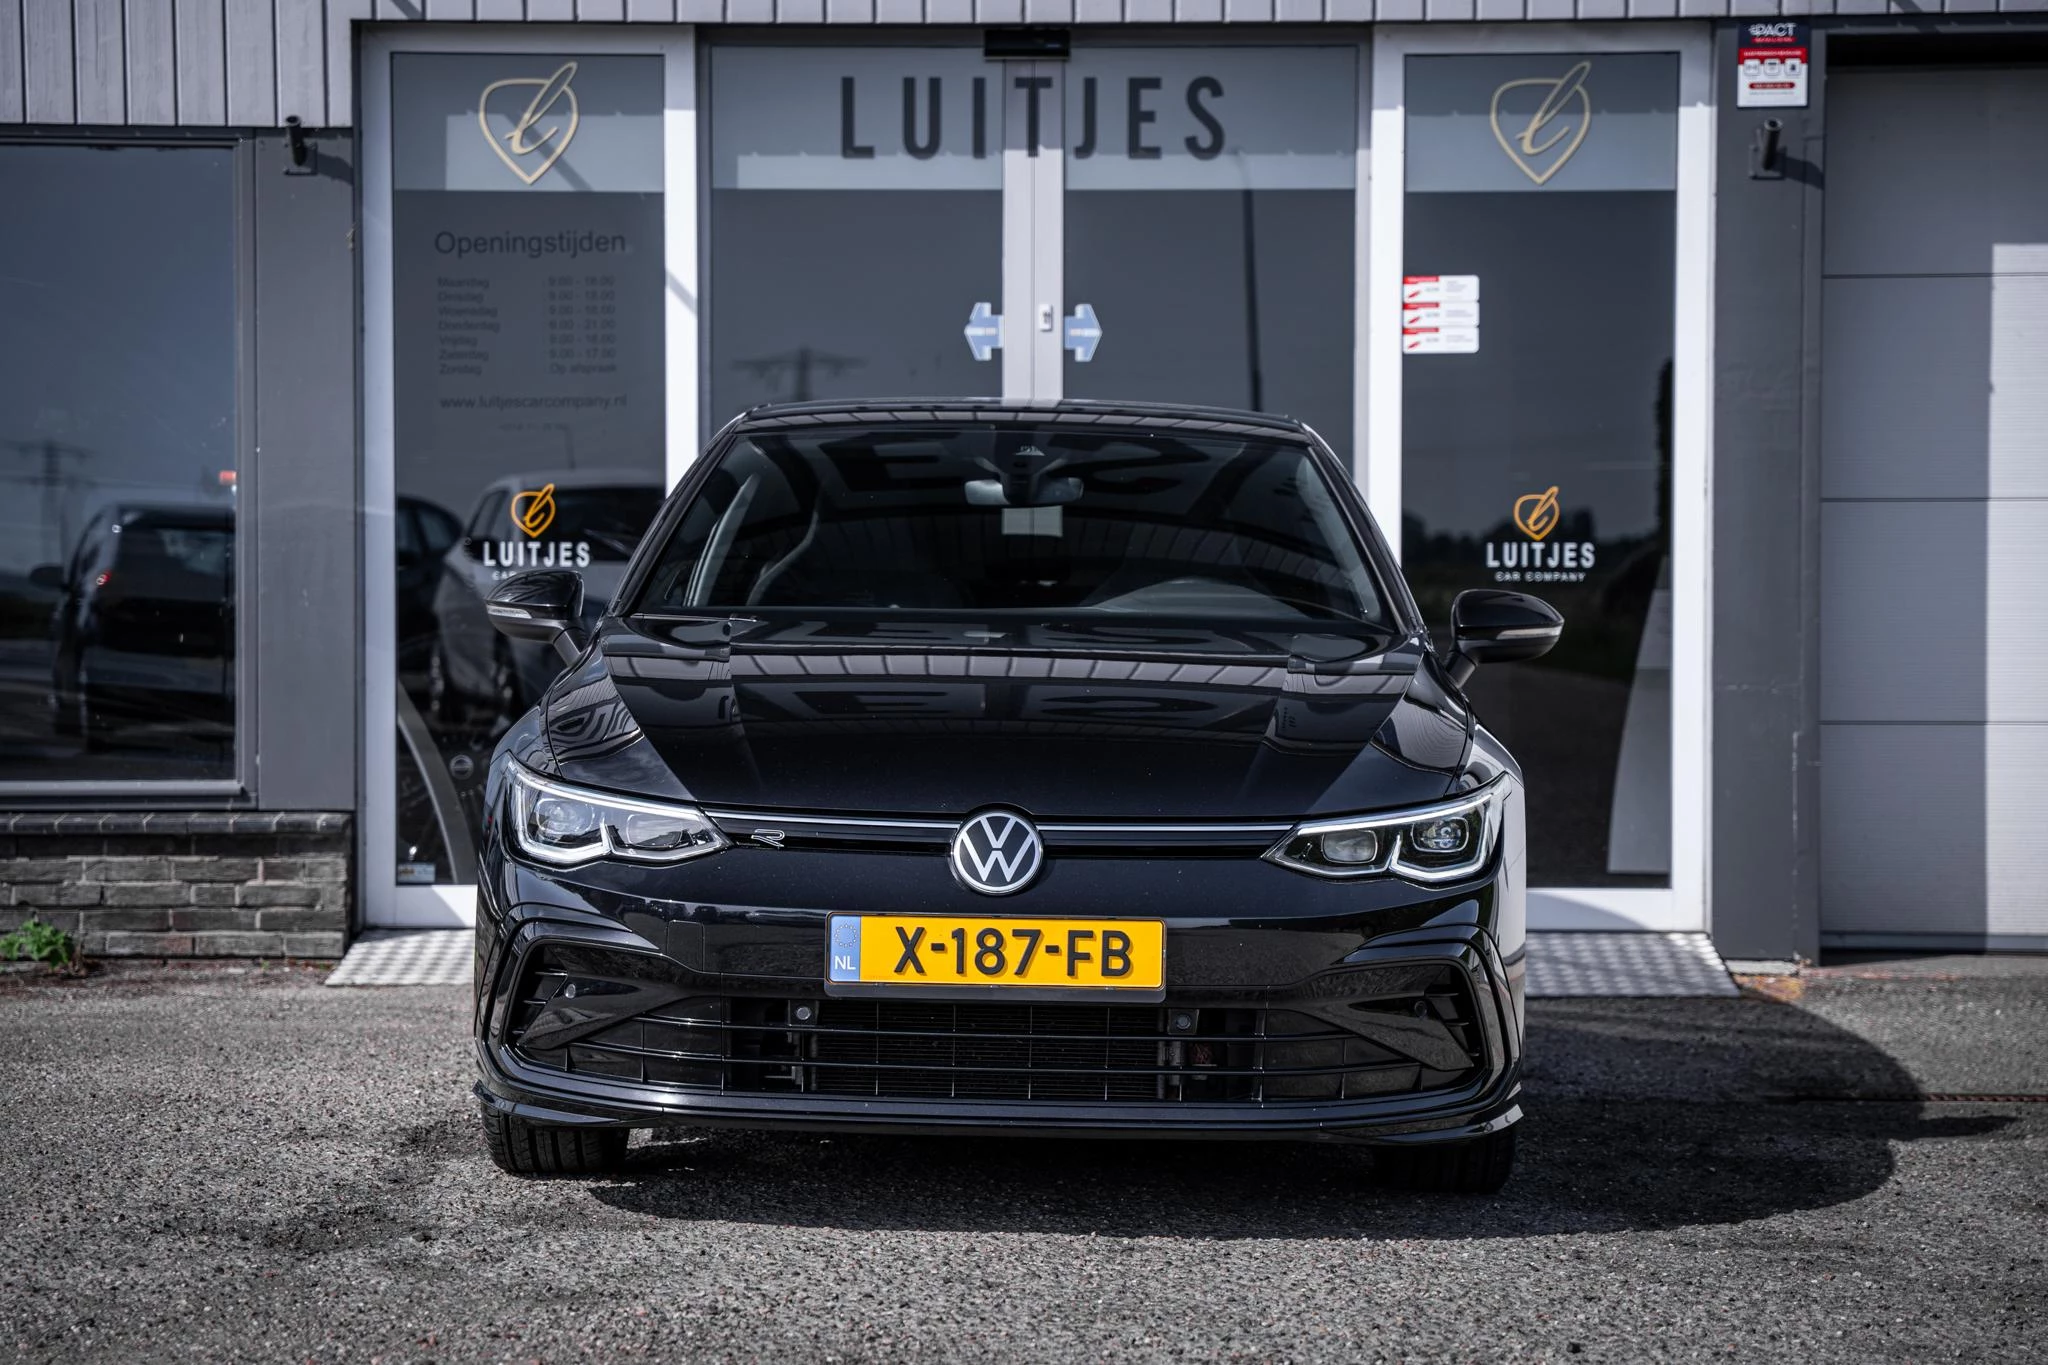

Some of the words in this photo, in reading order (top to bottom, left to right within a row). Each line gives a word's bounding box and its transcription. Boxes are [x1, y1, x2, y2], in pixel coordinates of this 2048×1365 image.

[841, 76, 1225, 160] LUITJES
[434, 230, 626, 259] Openingstijden
[440, 393, 627, 411] www.luitjescarcompany.nl
[483, 541, 590, 567] LUITJES
[1486, 542, 1595, 568] LUITJES
[1495, 571, 1520, 581] CAR
[1525, 571, 1585, 581] COMPANY
[834, 955, 857, 971] NL
[894, 925, 1133, 977] X-187-FB
